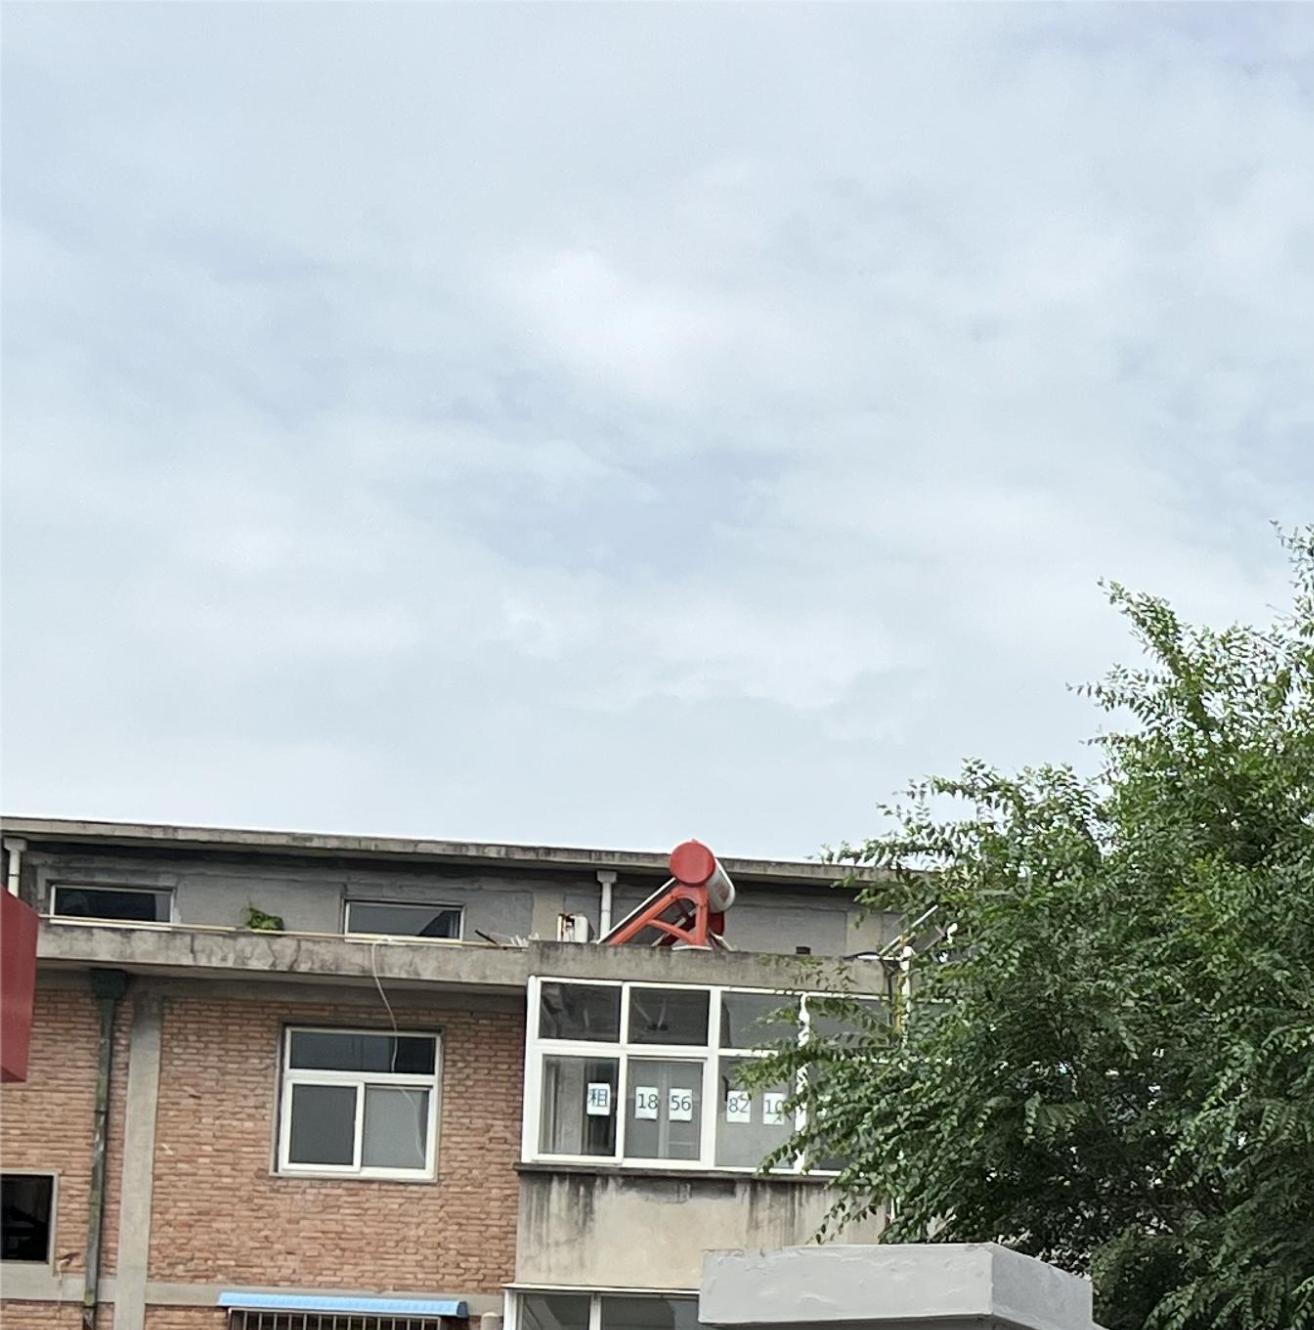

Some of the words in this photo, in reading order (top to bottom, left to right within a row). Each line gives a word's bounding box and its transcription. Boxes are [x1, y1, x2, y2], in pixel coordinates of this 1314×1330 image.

[638, 1093, 658, 1110] 18
[671, 1094, 691, 1111] 56
[728, 1097, 750, 1114] 82
